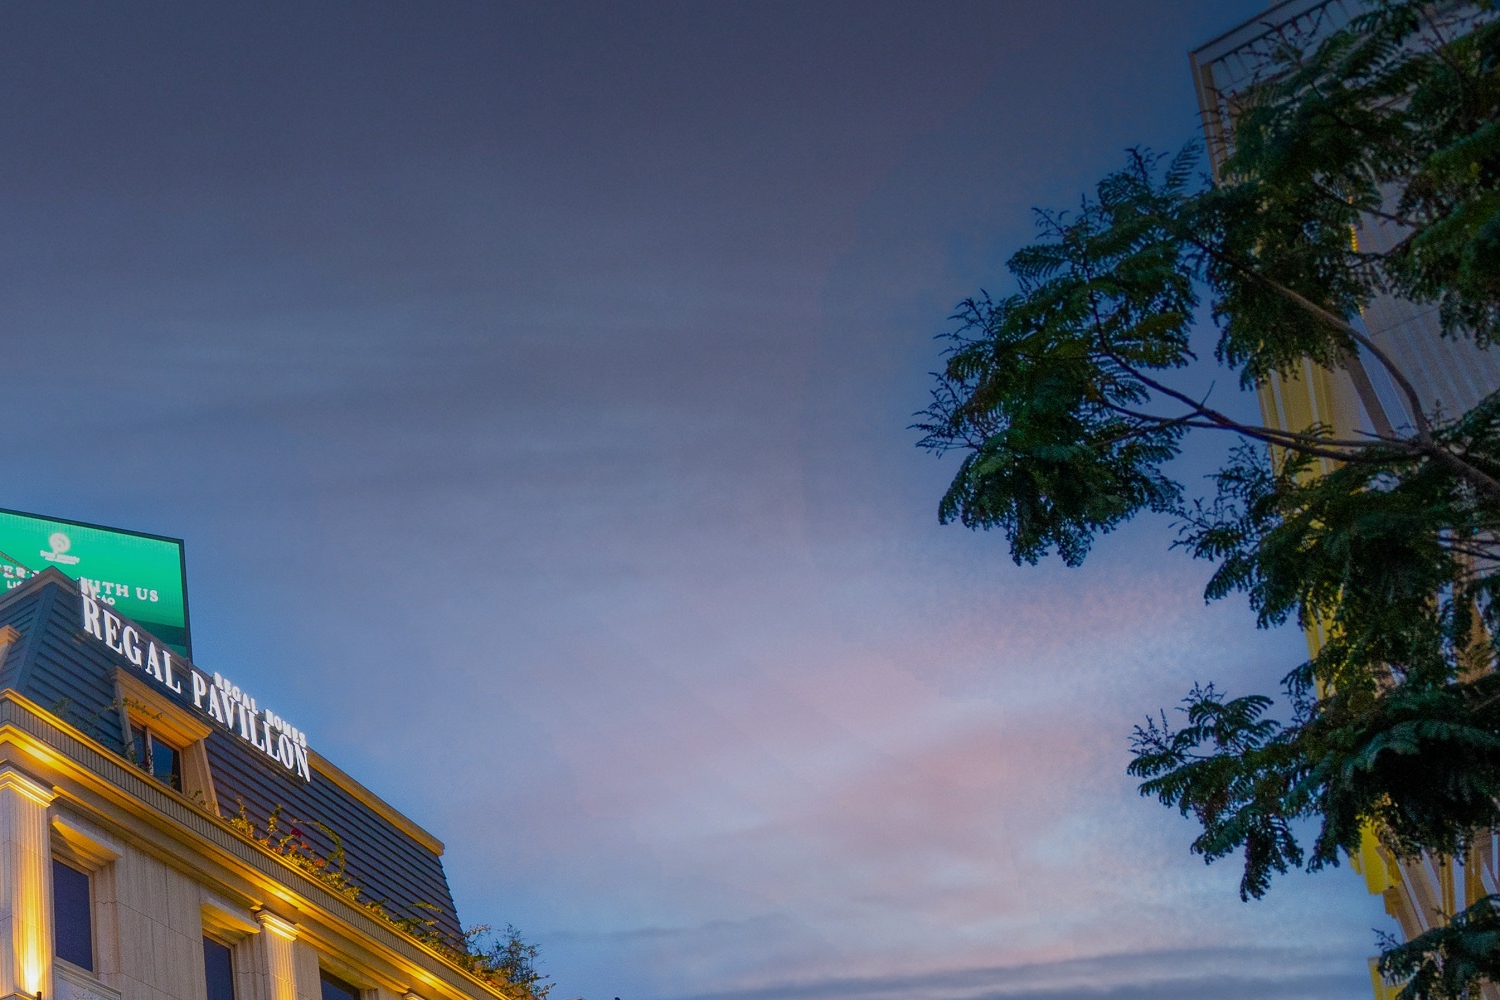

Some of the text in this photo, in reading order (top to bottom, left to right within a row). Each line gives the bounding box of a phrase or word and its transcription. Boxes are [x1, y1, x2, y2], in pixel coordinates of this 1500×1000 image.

[136, 587, 159, 602] US
[81, 593, 311, 782] REGAL PAVILLON
